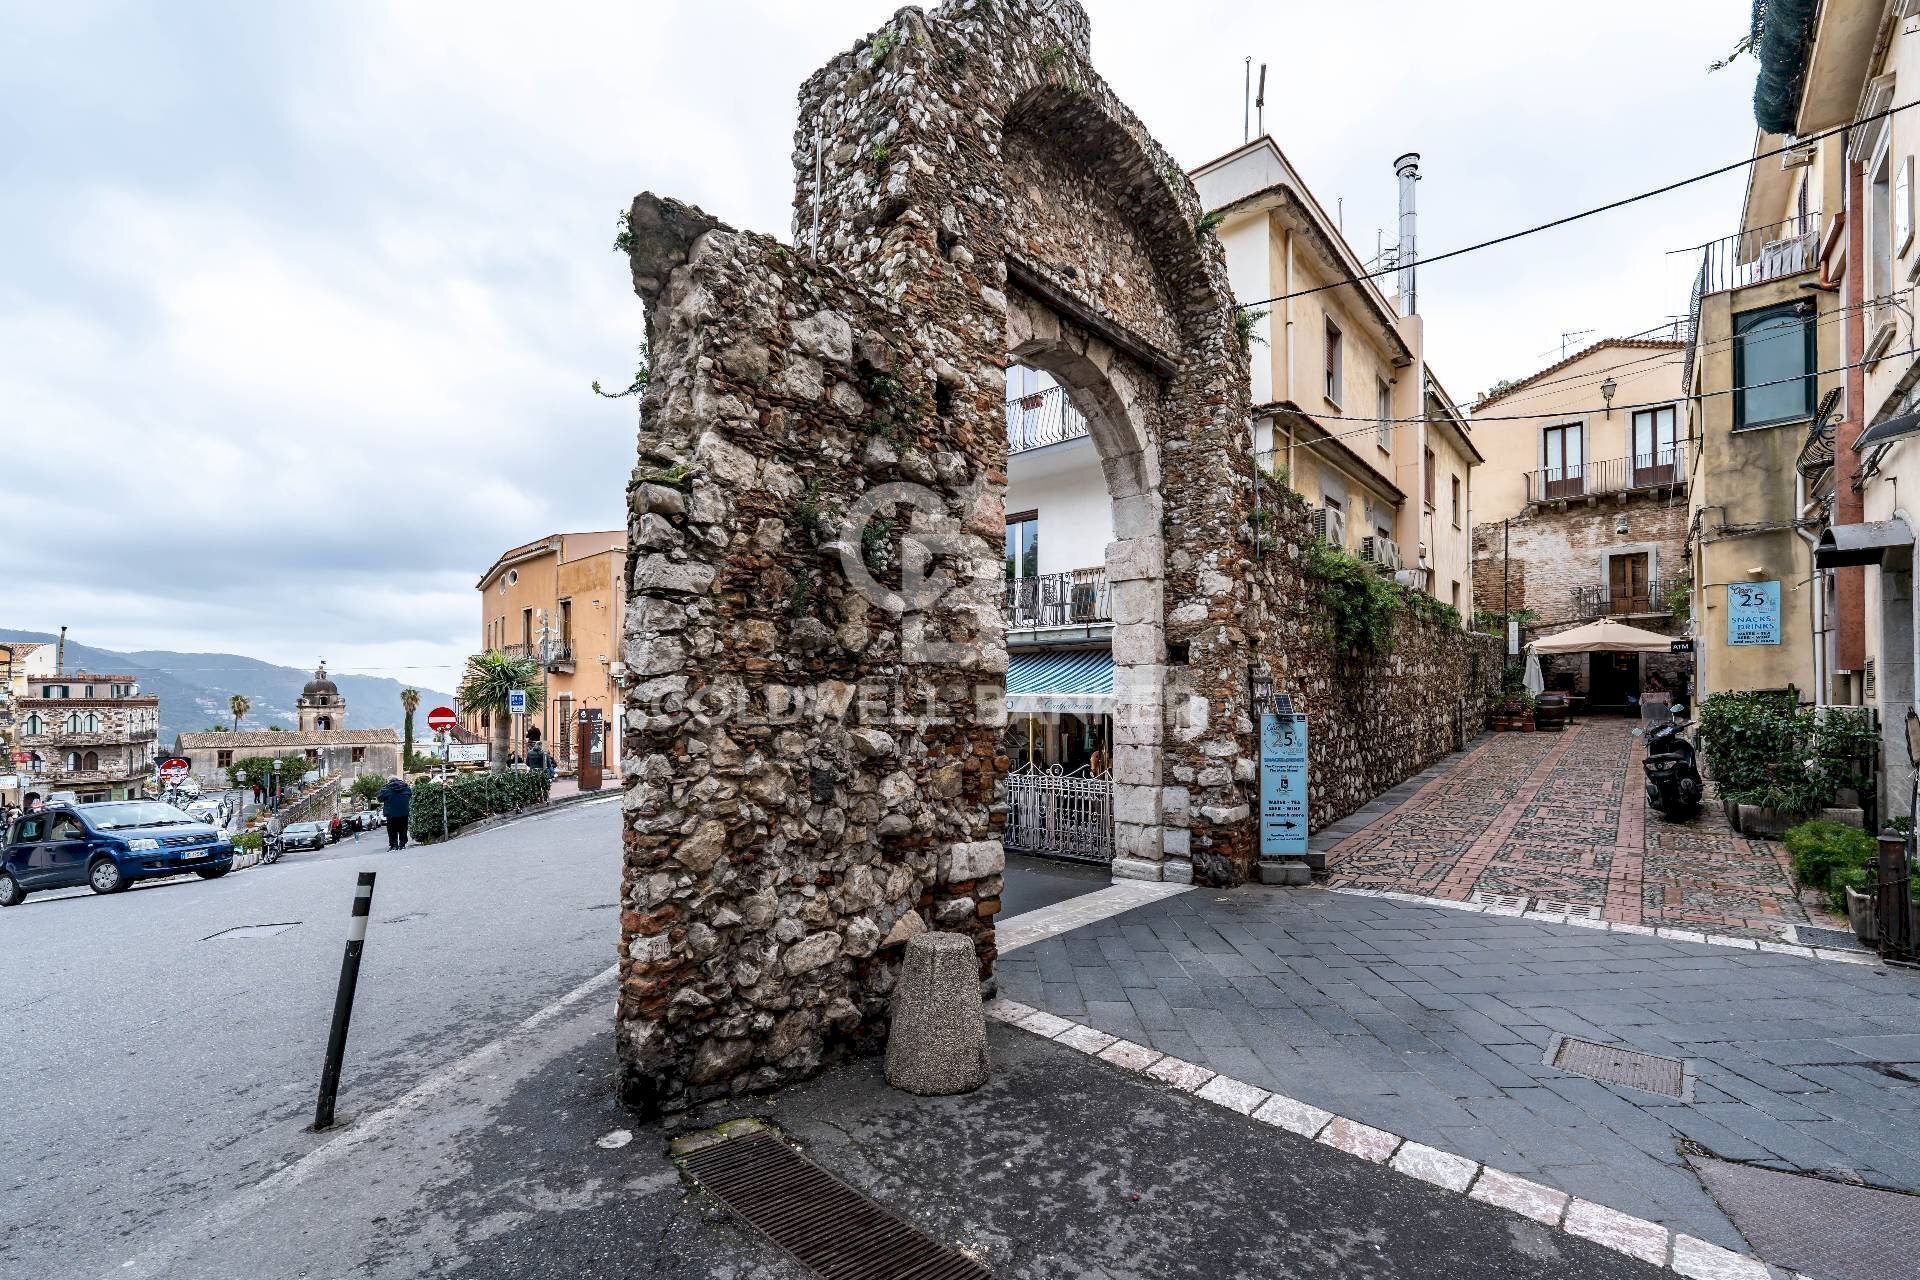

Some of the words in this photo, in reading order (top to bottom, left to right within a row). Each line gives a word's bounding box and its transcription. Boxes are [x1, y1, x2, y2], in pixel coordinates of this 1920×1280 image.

[1740, 593, 1765, 606] 25
[1731, 615, 1772, 623] SNACKS
[1271, 731, 1293, 748] 25
